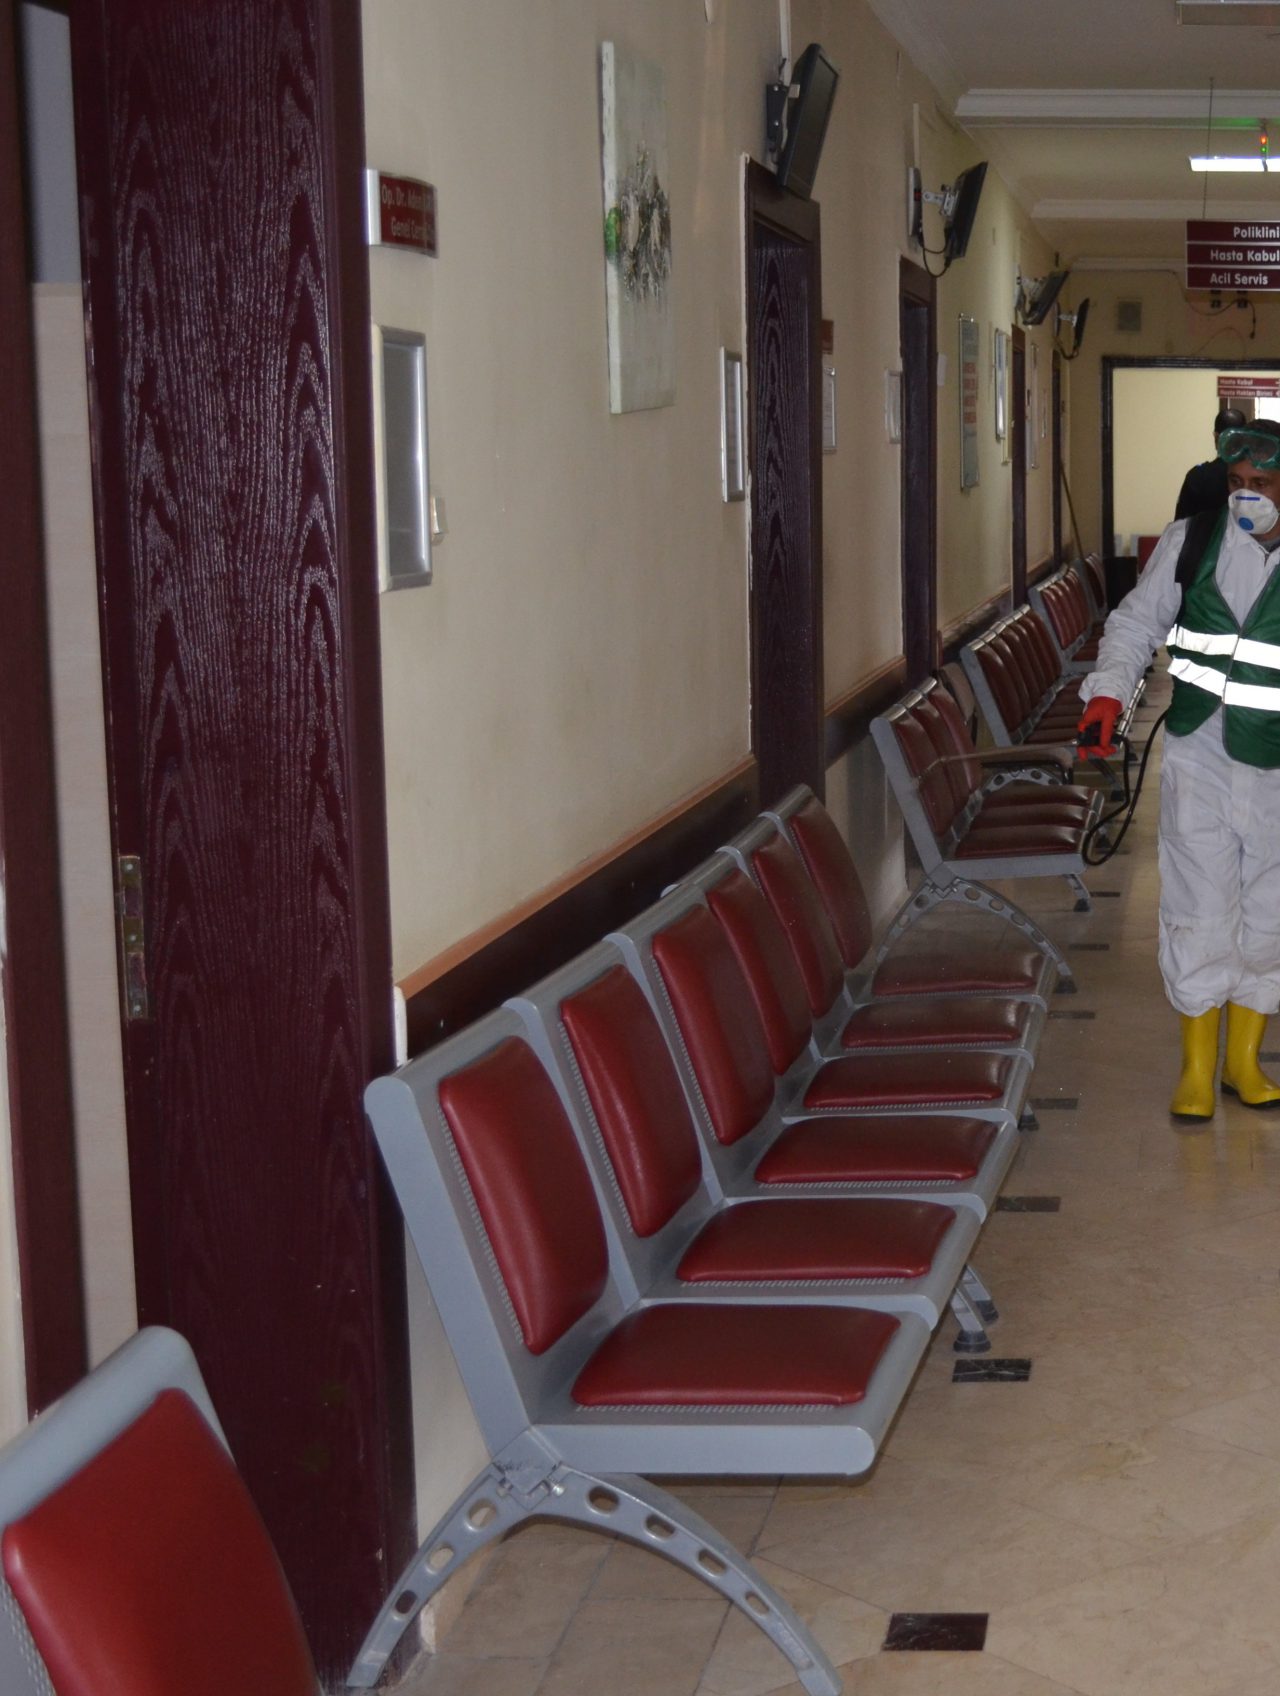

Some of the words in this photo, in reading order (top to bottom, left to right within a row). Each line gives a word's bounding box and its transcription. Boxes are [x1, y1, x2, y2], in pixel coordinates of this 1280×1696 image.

[381, 184, 396, 209] Op.
[396, 187, 408, 208] Dr.
[1210, 250, 1243, 262] Hasta
[1247, 249, 1280, 262] Kabul
[1209, 272, 1231, 285] Acil
[1234, 272, 1269, 286] Servis
